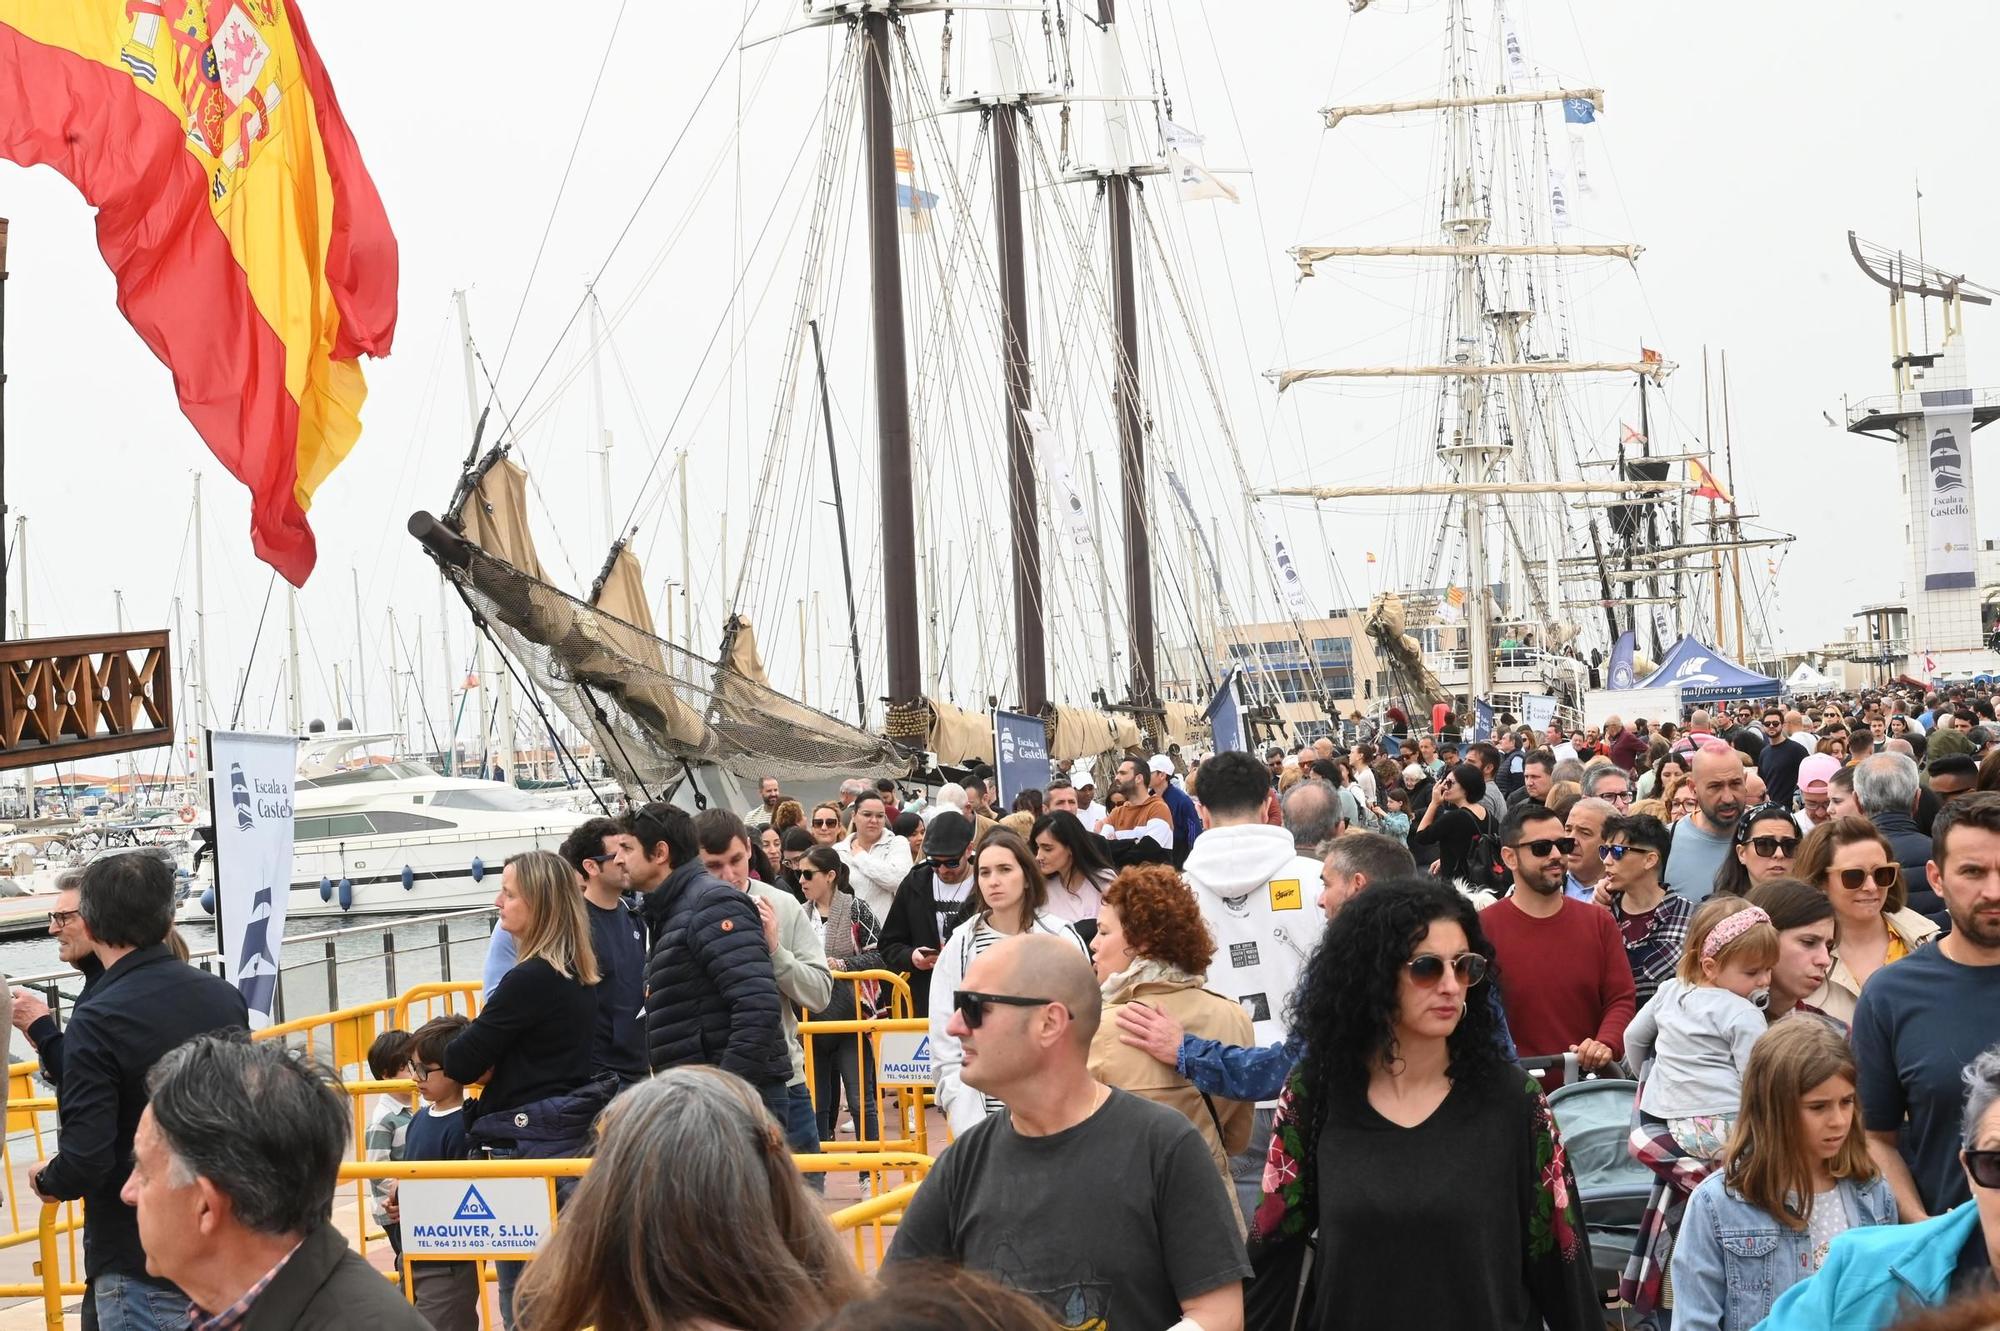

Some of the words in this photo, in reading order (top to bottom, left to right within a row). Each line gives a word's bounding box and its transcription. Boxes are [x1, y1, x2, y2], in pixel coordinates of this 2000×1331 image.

[1934, 495, 1957, 506] Escala
[1930, 504, 1969, 517] Castelló
[1017, 737, 1033, 747] Escala
[254, 778, 281, 794] Escala
[282, 783, 288, 794] a
[884, 1063, 931, 1073] MAQUIVE
[462, 1204, 486, 1213] MQV
[413, 1225, 494, 1239] MAQUIVER,
[499, 1225, 539, 1237] S.L.U.
[418, 1240, 432, 1248] TEL.
[434, 1240, 449, 1248] 964
[452, 1240, 466, 1248] 215
[469, 1240, 485, 1248] 403
[492, 1238, 536, 1248] CASTELLÓN
